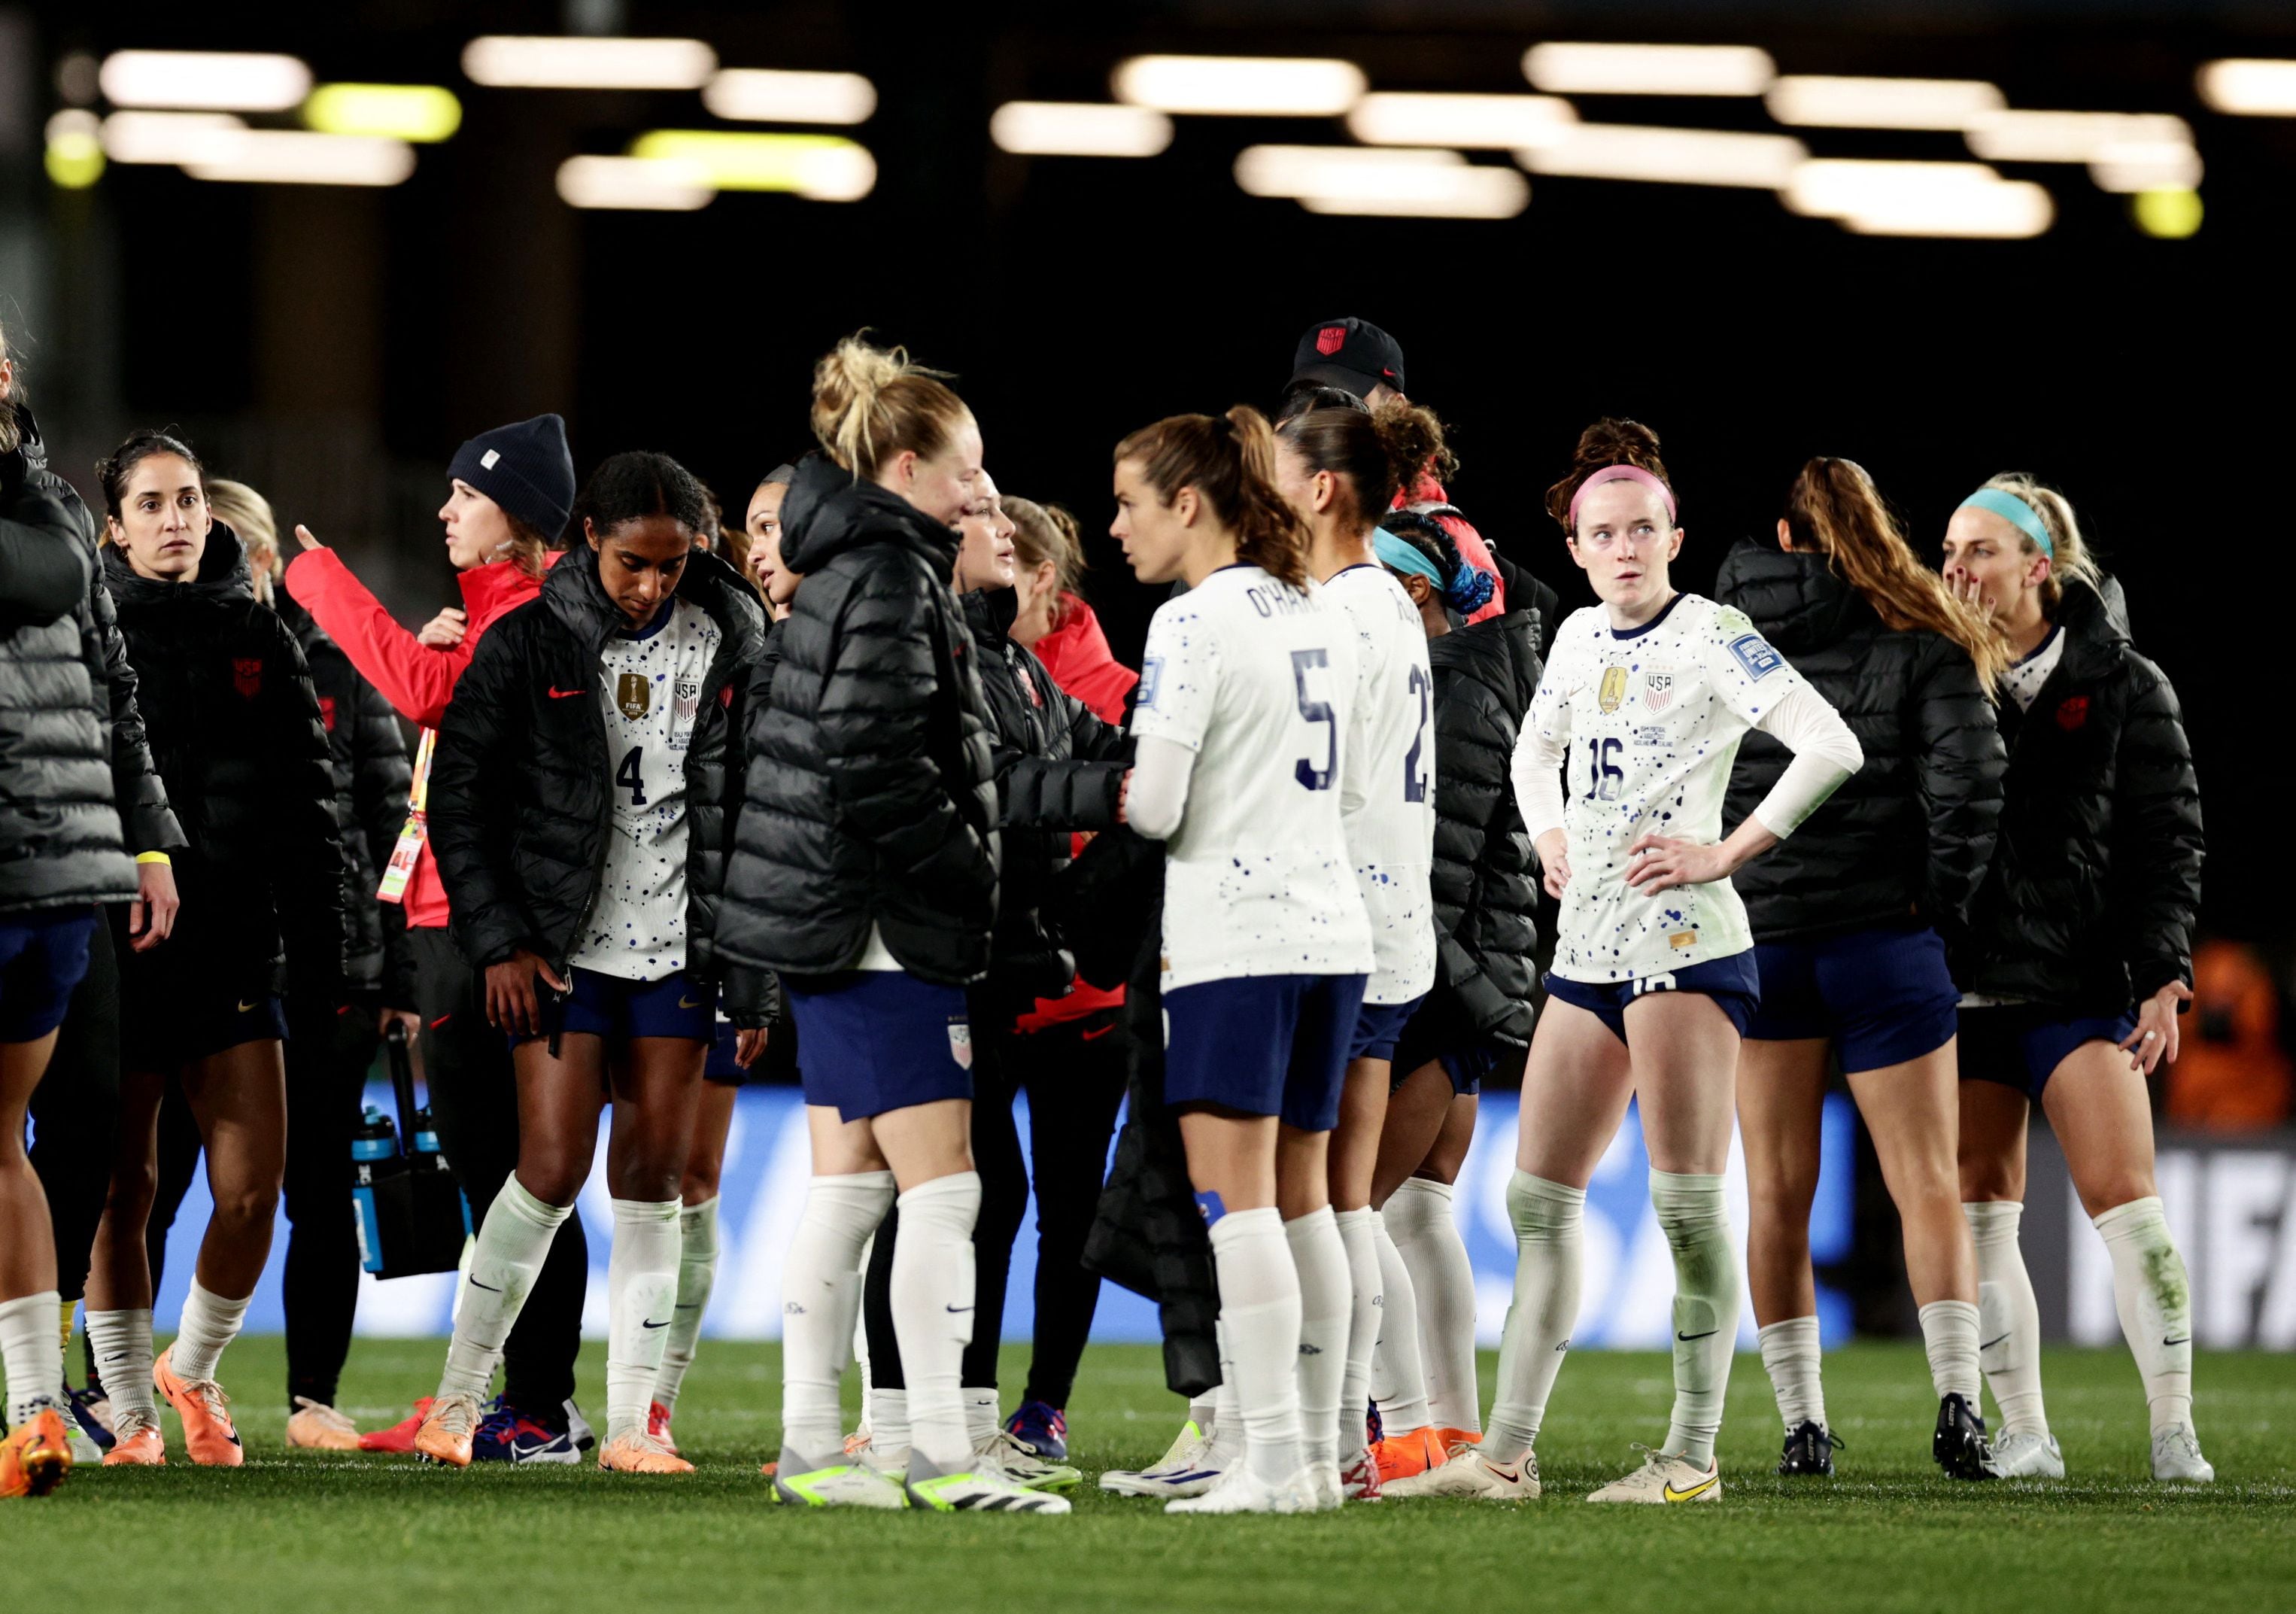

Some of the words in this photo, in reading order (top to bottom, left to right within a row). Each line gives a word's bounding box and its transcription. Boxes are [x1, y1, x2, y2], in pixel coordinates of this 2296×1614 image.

[233, 660, 262, 676] USA
[1648, 676, 1672, 691] USA
[625, 702, 642, 710] FIFA
[675, 682, 697, 699] USA
[1290, 648, 1338, 791] 5
[1405, 663, 1436, 810] 2
[616, 746, 647, 805] 4
[1583, 737, 1623, 801] 16
